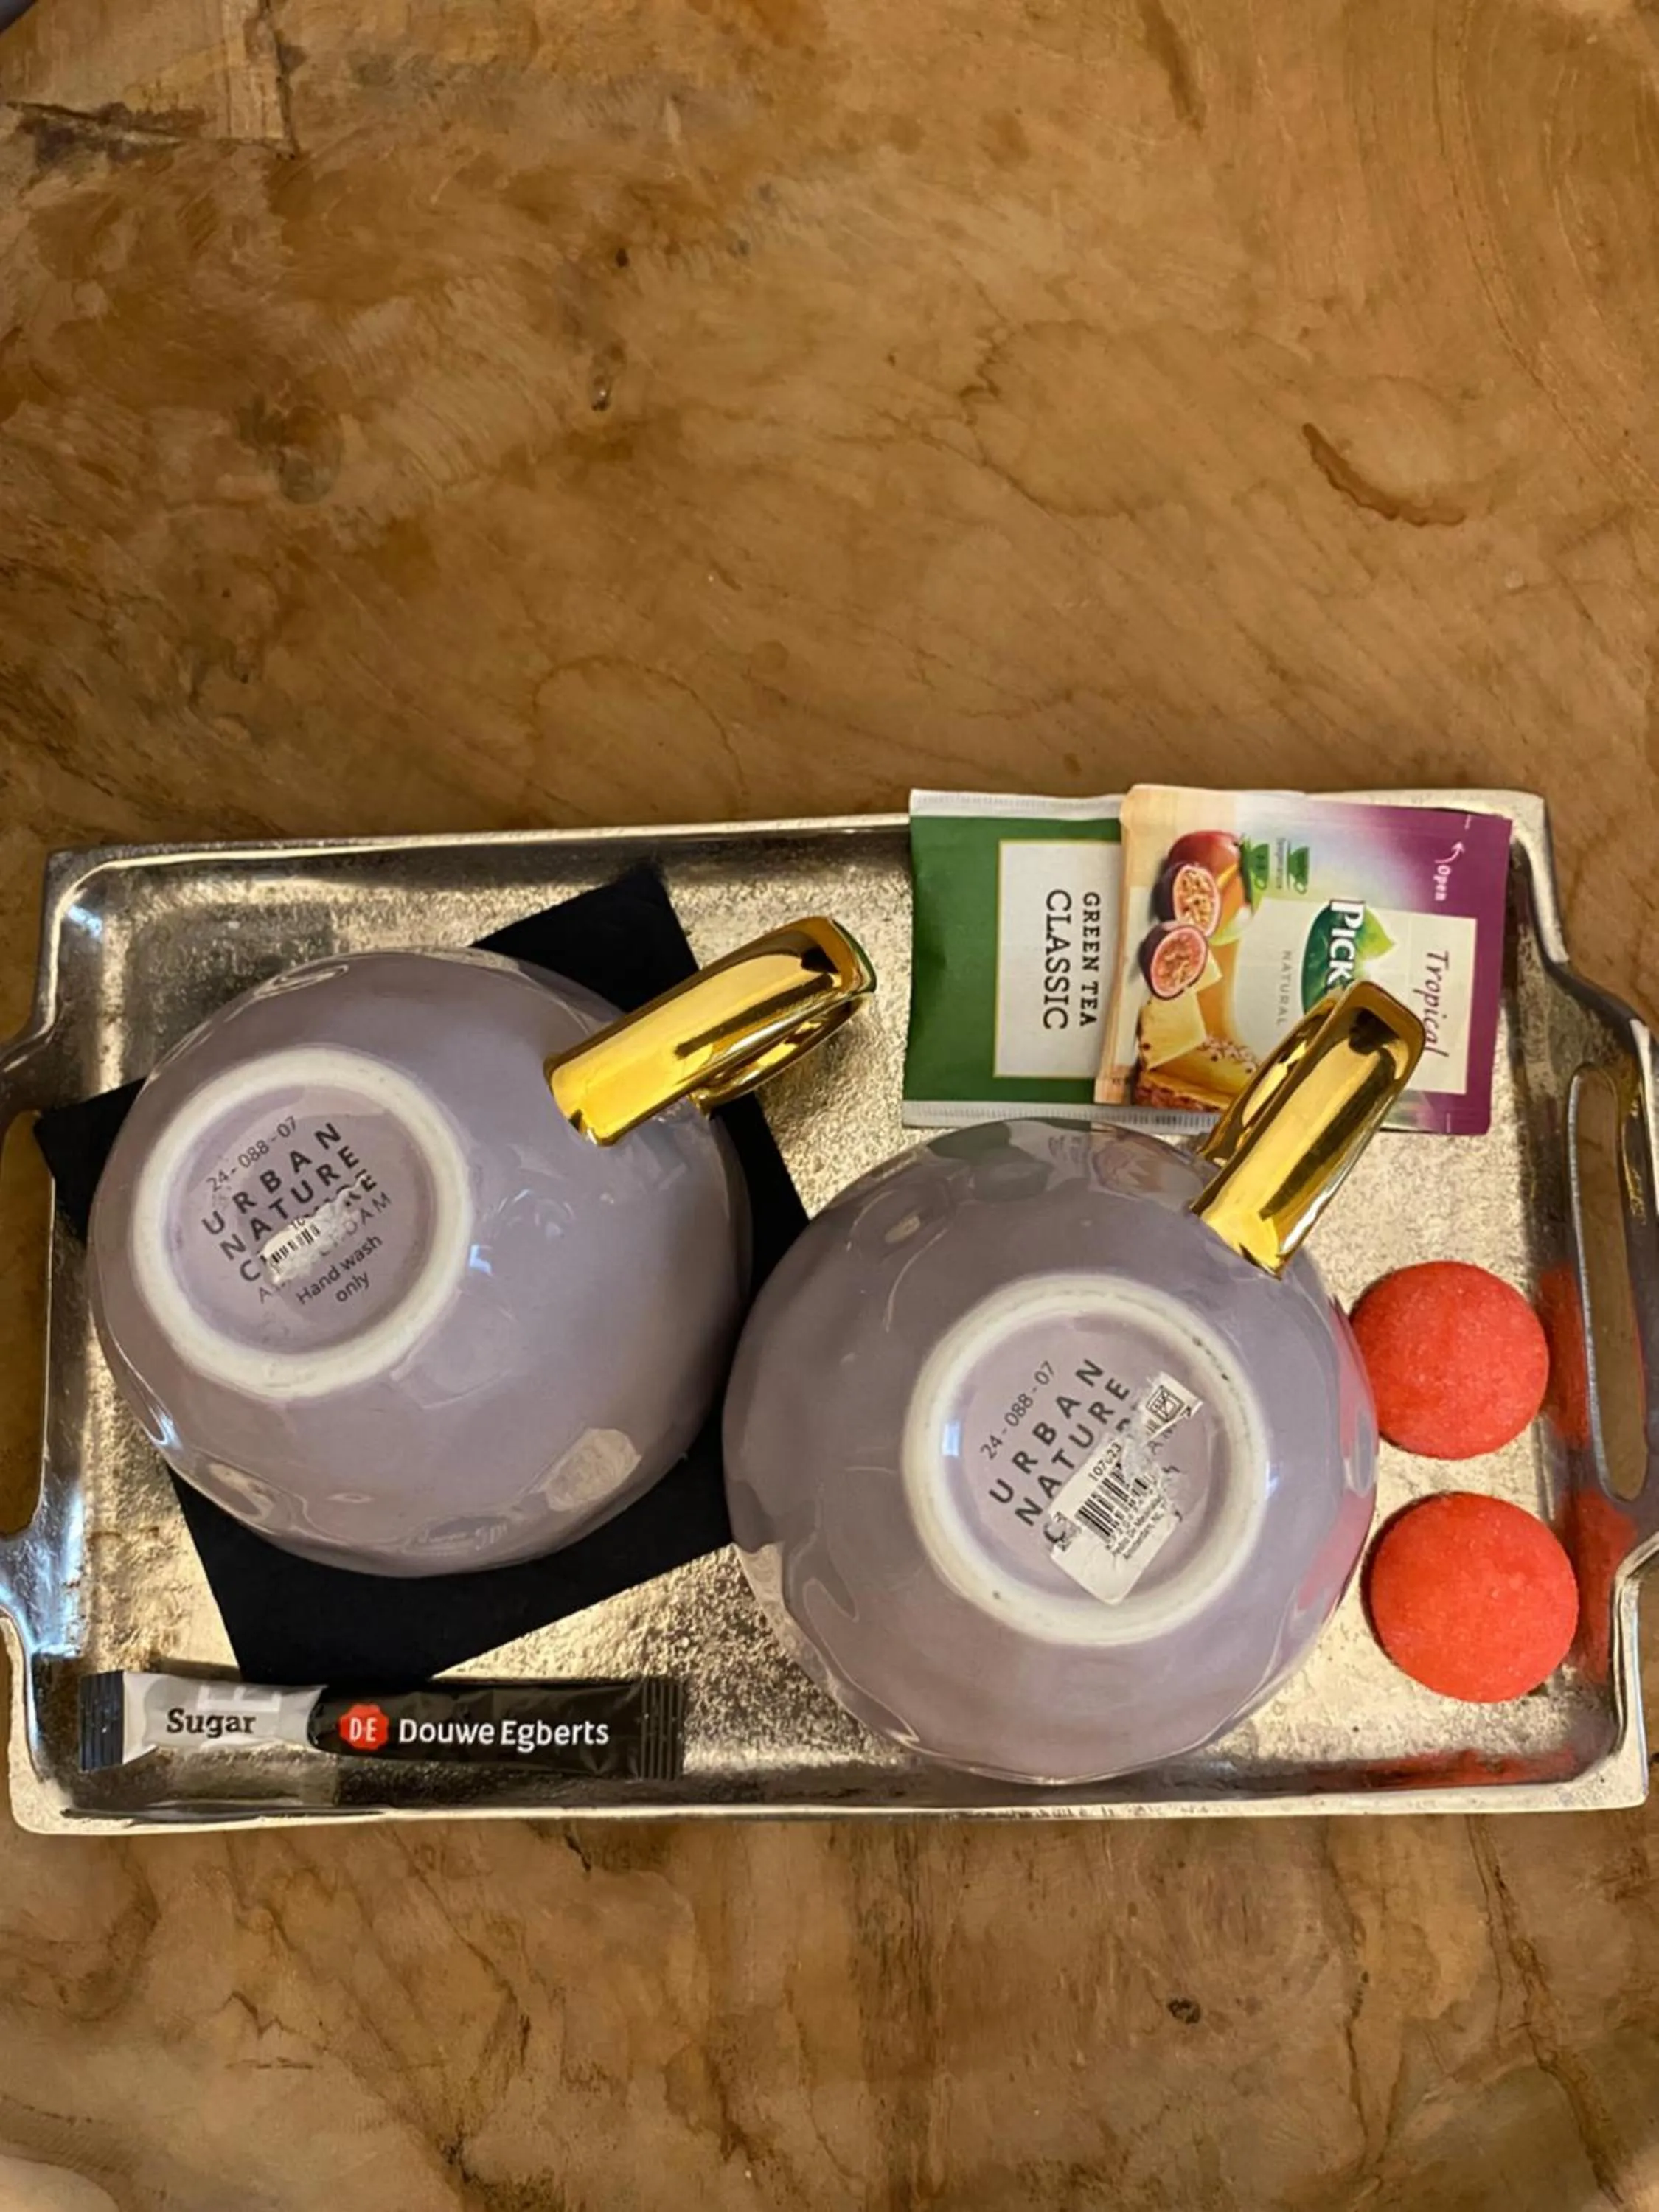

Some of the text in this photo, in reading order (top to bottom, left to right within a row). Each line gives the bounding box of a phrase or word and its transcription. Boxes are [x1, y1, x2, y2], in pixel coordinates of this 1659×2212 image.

[1433, 863, 1452, 902] Open
[1043, 889, 1072, 1029] CLASSIC
[1079, 891, 1101, 1026] GREEN TEA
[1327, 901, 1365, 987] PICK
[1276, 950, 1293, 1026] NATURAL
[1413, 950, 1450, 1058] Tropical
[201, 1122, 341, 1235] URBAN
[219, 1146, 360, 1261] NATURE
[296, 1234, 383, 1305] Hand wash
[335, 1271, 370, 1303] only
[989, 1359, 1105, 1504] URBAN
[1015, 1377, 1130, 1526] NATURE
[166, 1708, 257, 1738] Sugar
[349, 1717, 378, 1742] DE
[399, 1718, 610, 1753] Douwe Egberts
